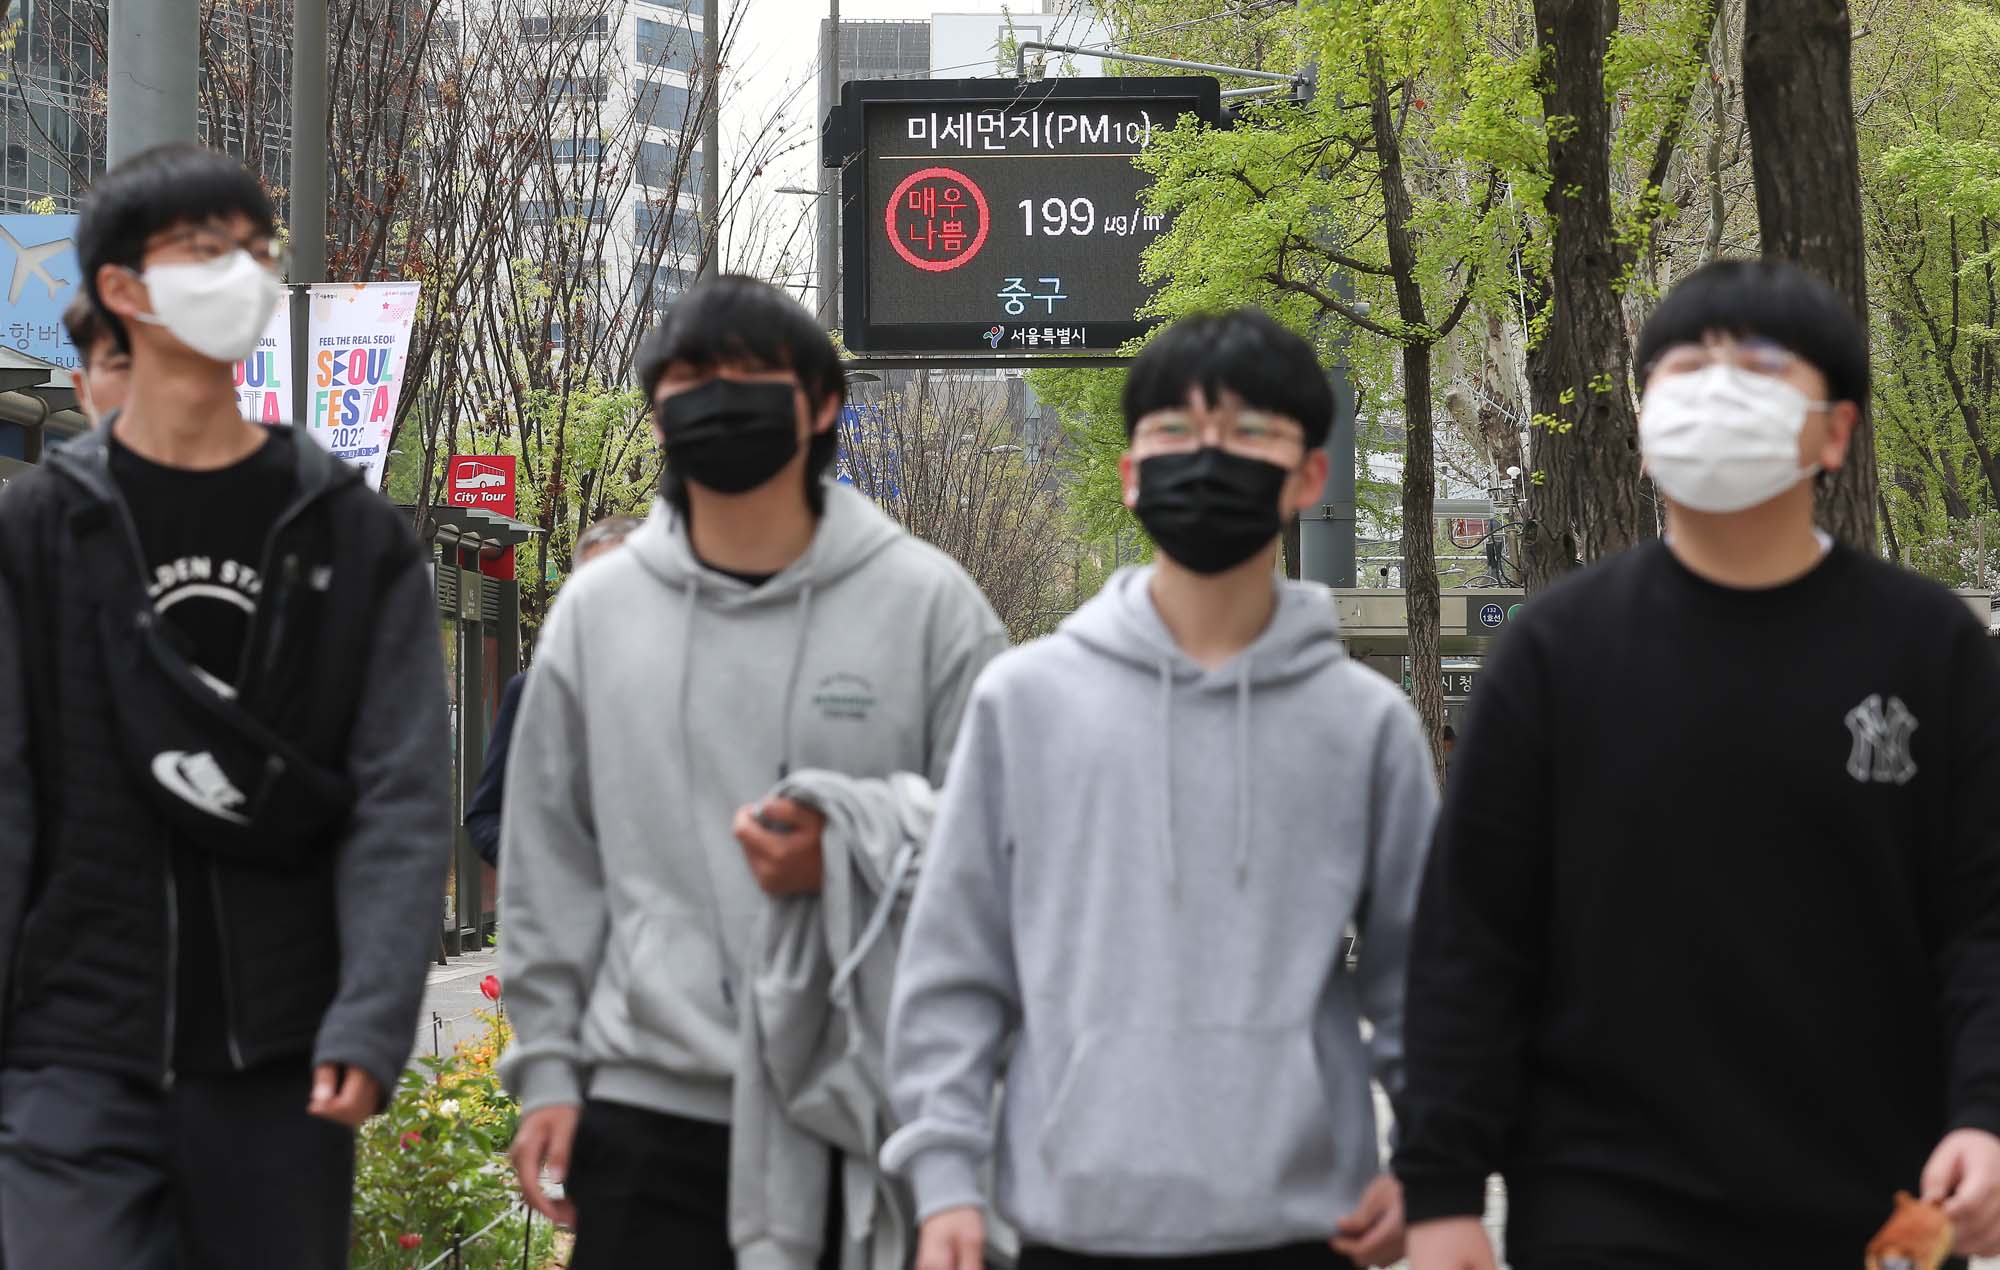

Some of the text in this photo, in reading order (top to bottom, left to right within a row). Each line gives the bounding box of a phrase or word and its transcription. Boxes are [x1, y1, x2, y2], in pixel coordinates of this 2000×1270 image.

[908, 110, 1151, 150] 미세먼지(PM10)
[908, 187, 967, 218] 매우
[1018, 197, 1095, 237] 199
[909, 221, 968, 252] 나쁨
[996, 276, 1068, 316] 중구
[319, 336, 335, 346] FEEL
[336, 336, 351, 345] THE
[352, 335, 372, 345] REAL
[1011, 327, 1086, 345] 서울특별시
[316, 347, 393, 388] SEOUL
[315, 385, 389, 428] FESTA
[454, 491, 507, 504] City Tour
[1482, 613, 1501, 623] 1호선
